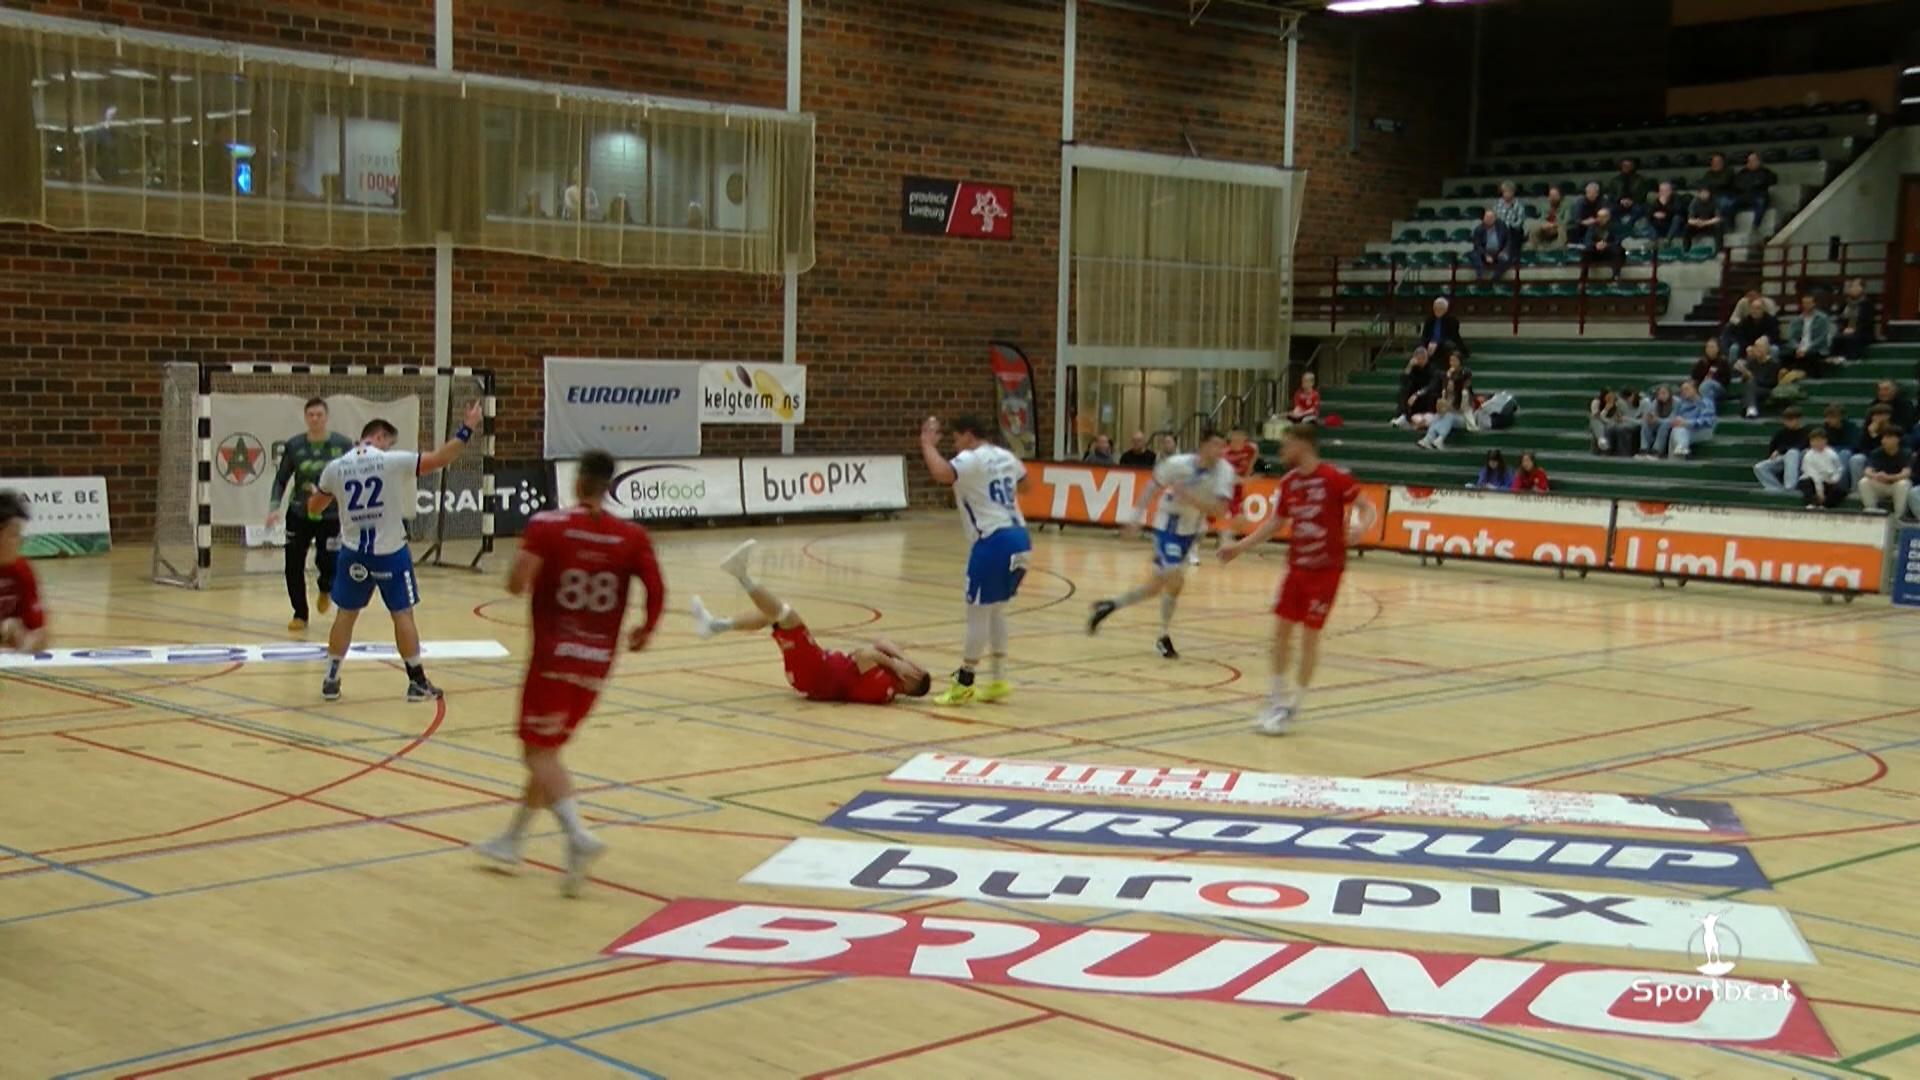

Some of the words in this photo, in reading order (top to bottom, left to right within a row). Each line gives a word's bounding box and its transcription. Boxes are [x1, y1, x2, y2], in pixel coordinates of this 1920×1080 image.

[567, 385, 681, 405] EUROQUIP
[704, 386, 800, 416] kelgtermns
[344, 476, 385, 512] 22
[630, 479, 706, 501] Bidfood
[555, 568, 619, 613] 88
[847, 799, 1739, 870] EUROQUIP
[613, 904, 1797, 1042] BRUNO
